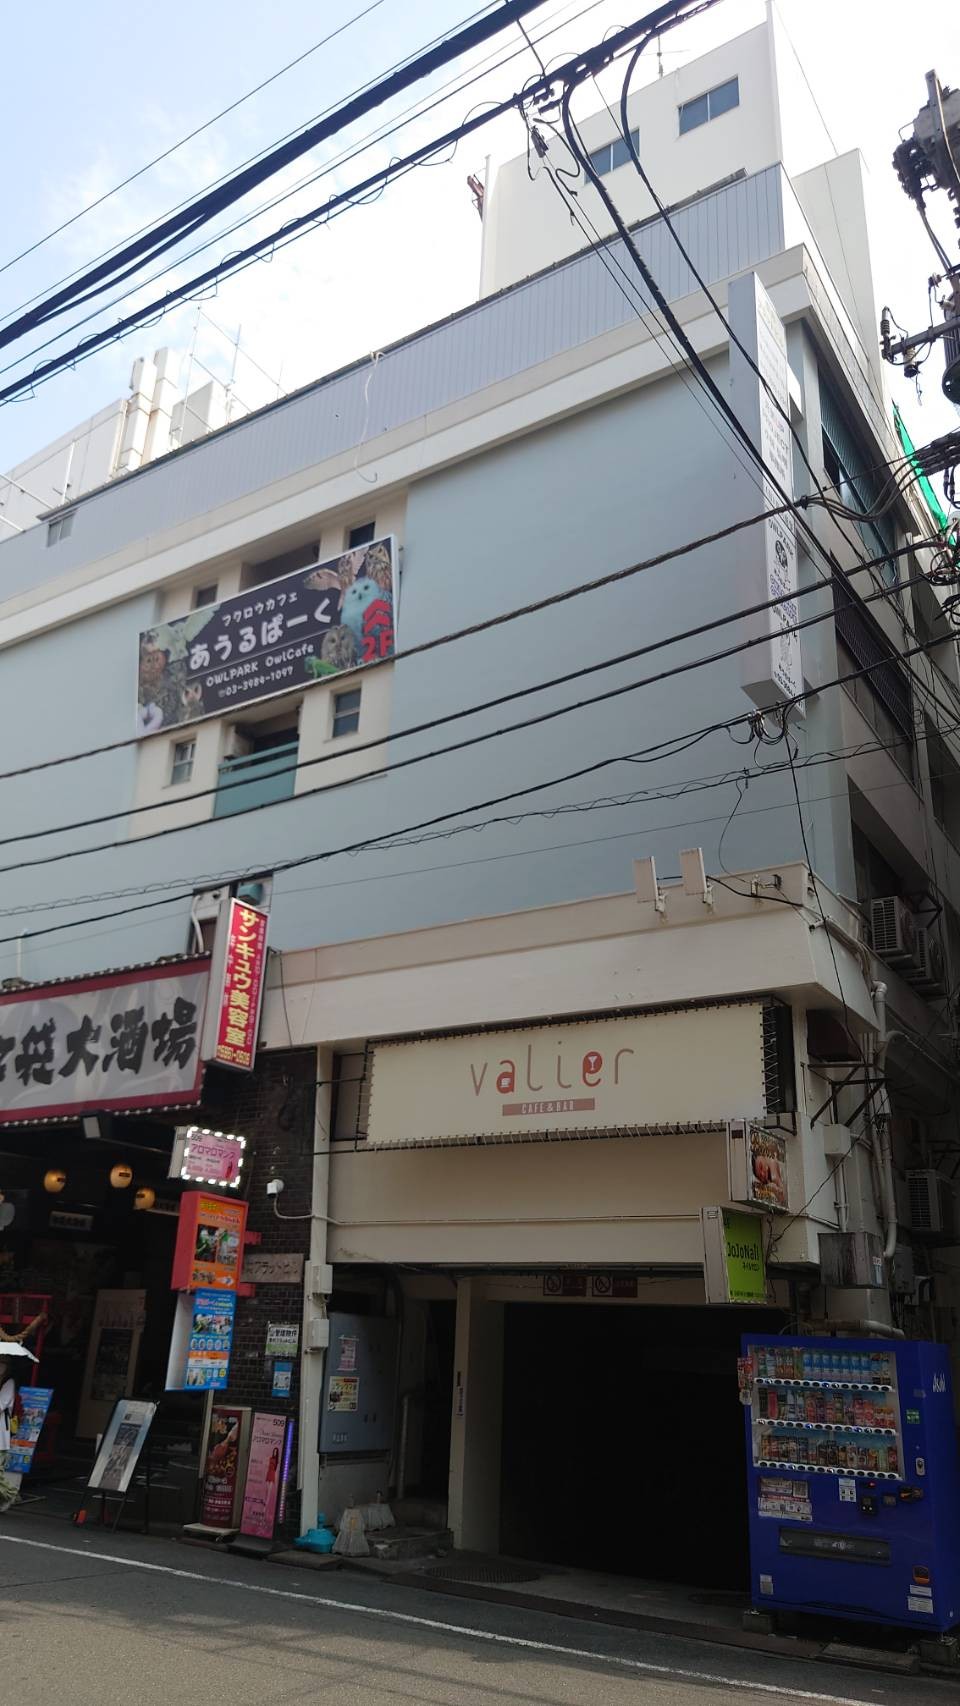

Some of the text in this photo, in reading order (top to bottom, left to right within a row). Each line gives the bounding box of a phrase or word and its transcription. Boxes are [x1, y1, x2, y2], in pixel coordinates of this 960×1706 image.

[221, 592, 299, 627] フクロウカフェ
[189, 598, 332, 670] あうるぱーく
[360, 629, 395, 664] 2F
[206, 643, 315, 688] OWLPARK OwlCafe
[225, 908, 260, 1048] サンキュウ美容室
[470, 1040, 634, 1096] valier
[727, 1241, 759, 1261] JoJoNail
